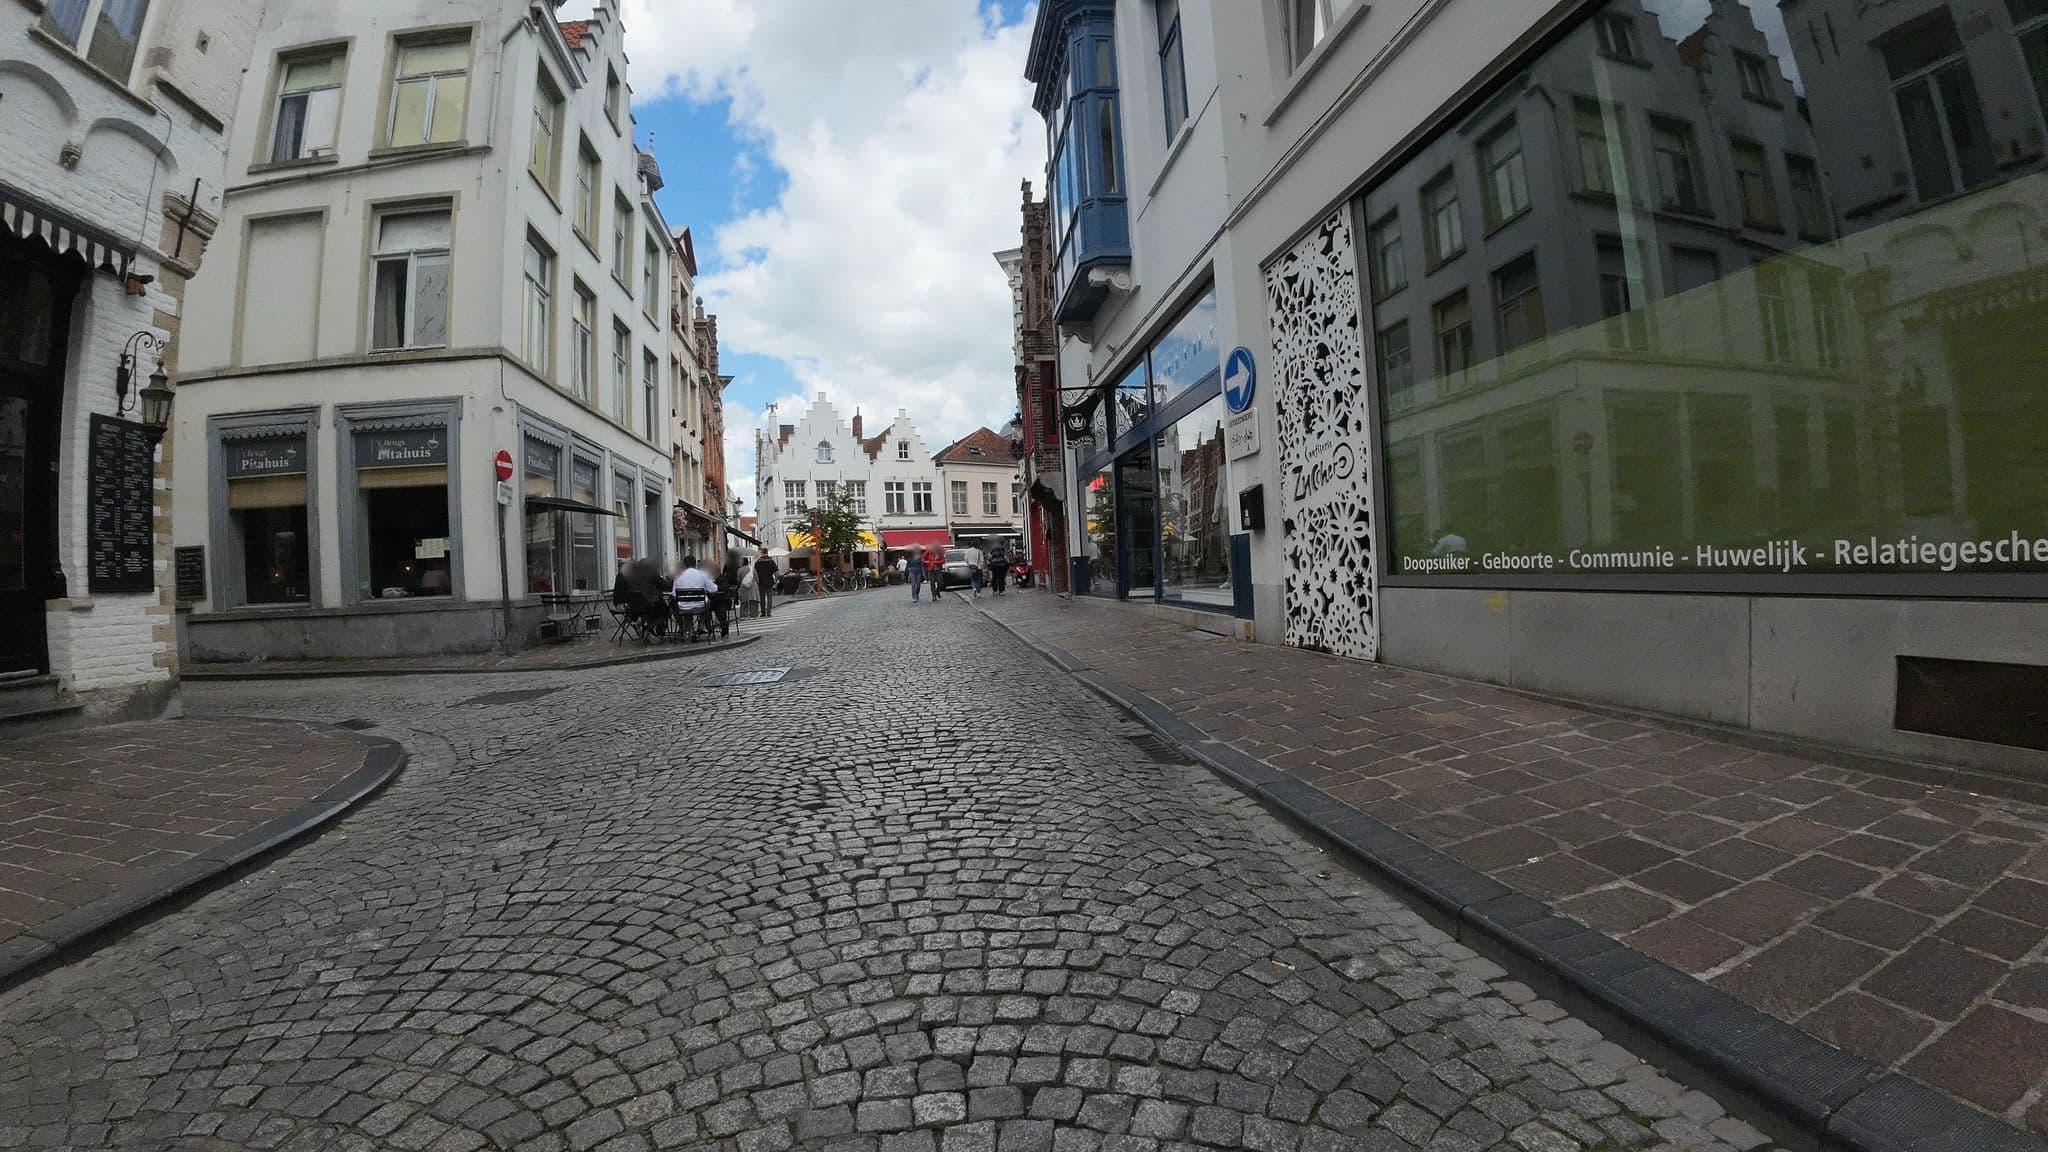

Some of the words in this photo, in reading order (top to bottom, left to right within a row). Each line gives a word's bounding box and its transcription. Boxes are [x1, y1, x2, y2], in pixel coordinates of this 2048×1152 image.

[1403, 555, 1471, 574] Doopsuiker
[1482, 552, 1553, 570] Geboorte
[1569, 545, 1674, 568] Communie
[1696, 540, 1807, 572] Huwelijk
[1835, 531, 2048, 571] Relatiegesche
